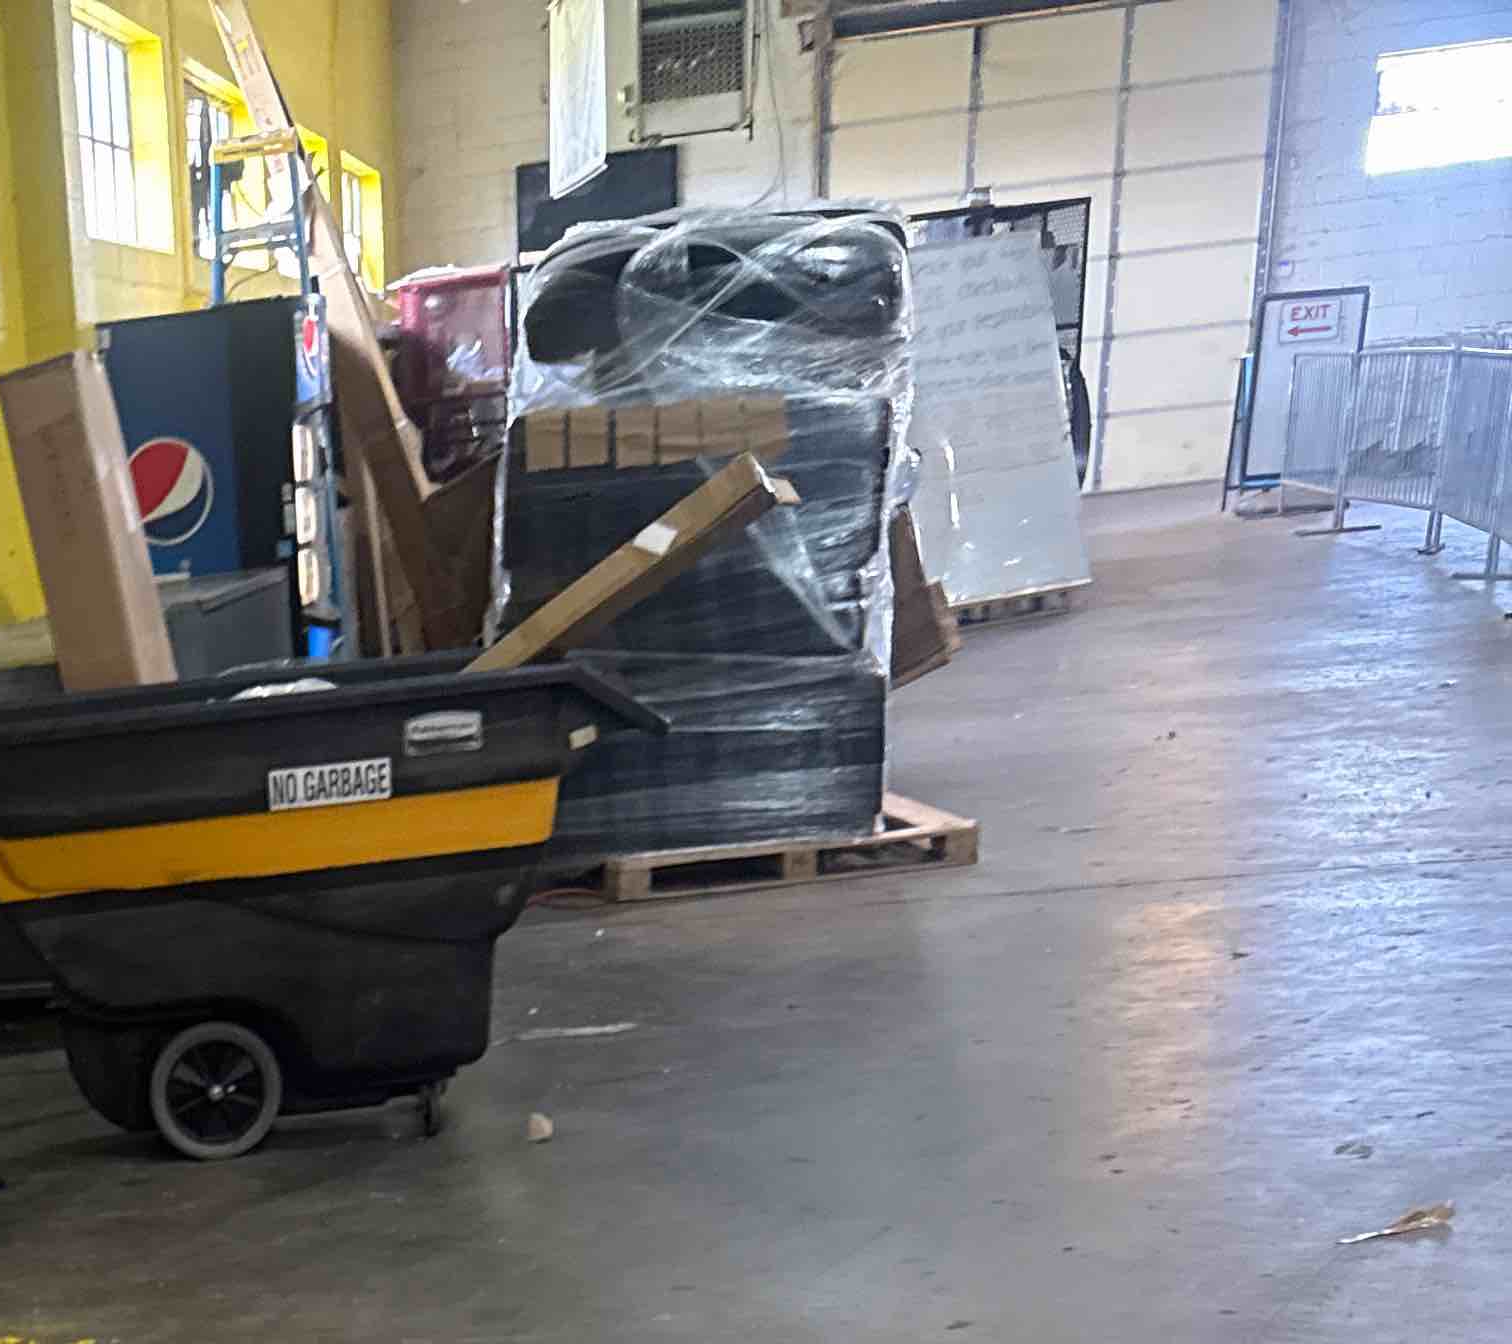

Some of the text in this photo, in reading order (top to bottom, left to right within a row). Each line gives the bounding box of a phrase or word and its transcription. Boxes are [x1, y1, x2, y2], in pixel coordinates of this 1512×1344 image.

[1290, 304, 1332, 322] EXIT
[272, 762, 387, 804] NO GARBAGE
